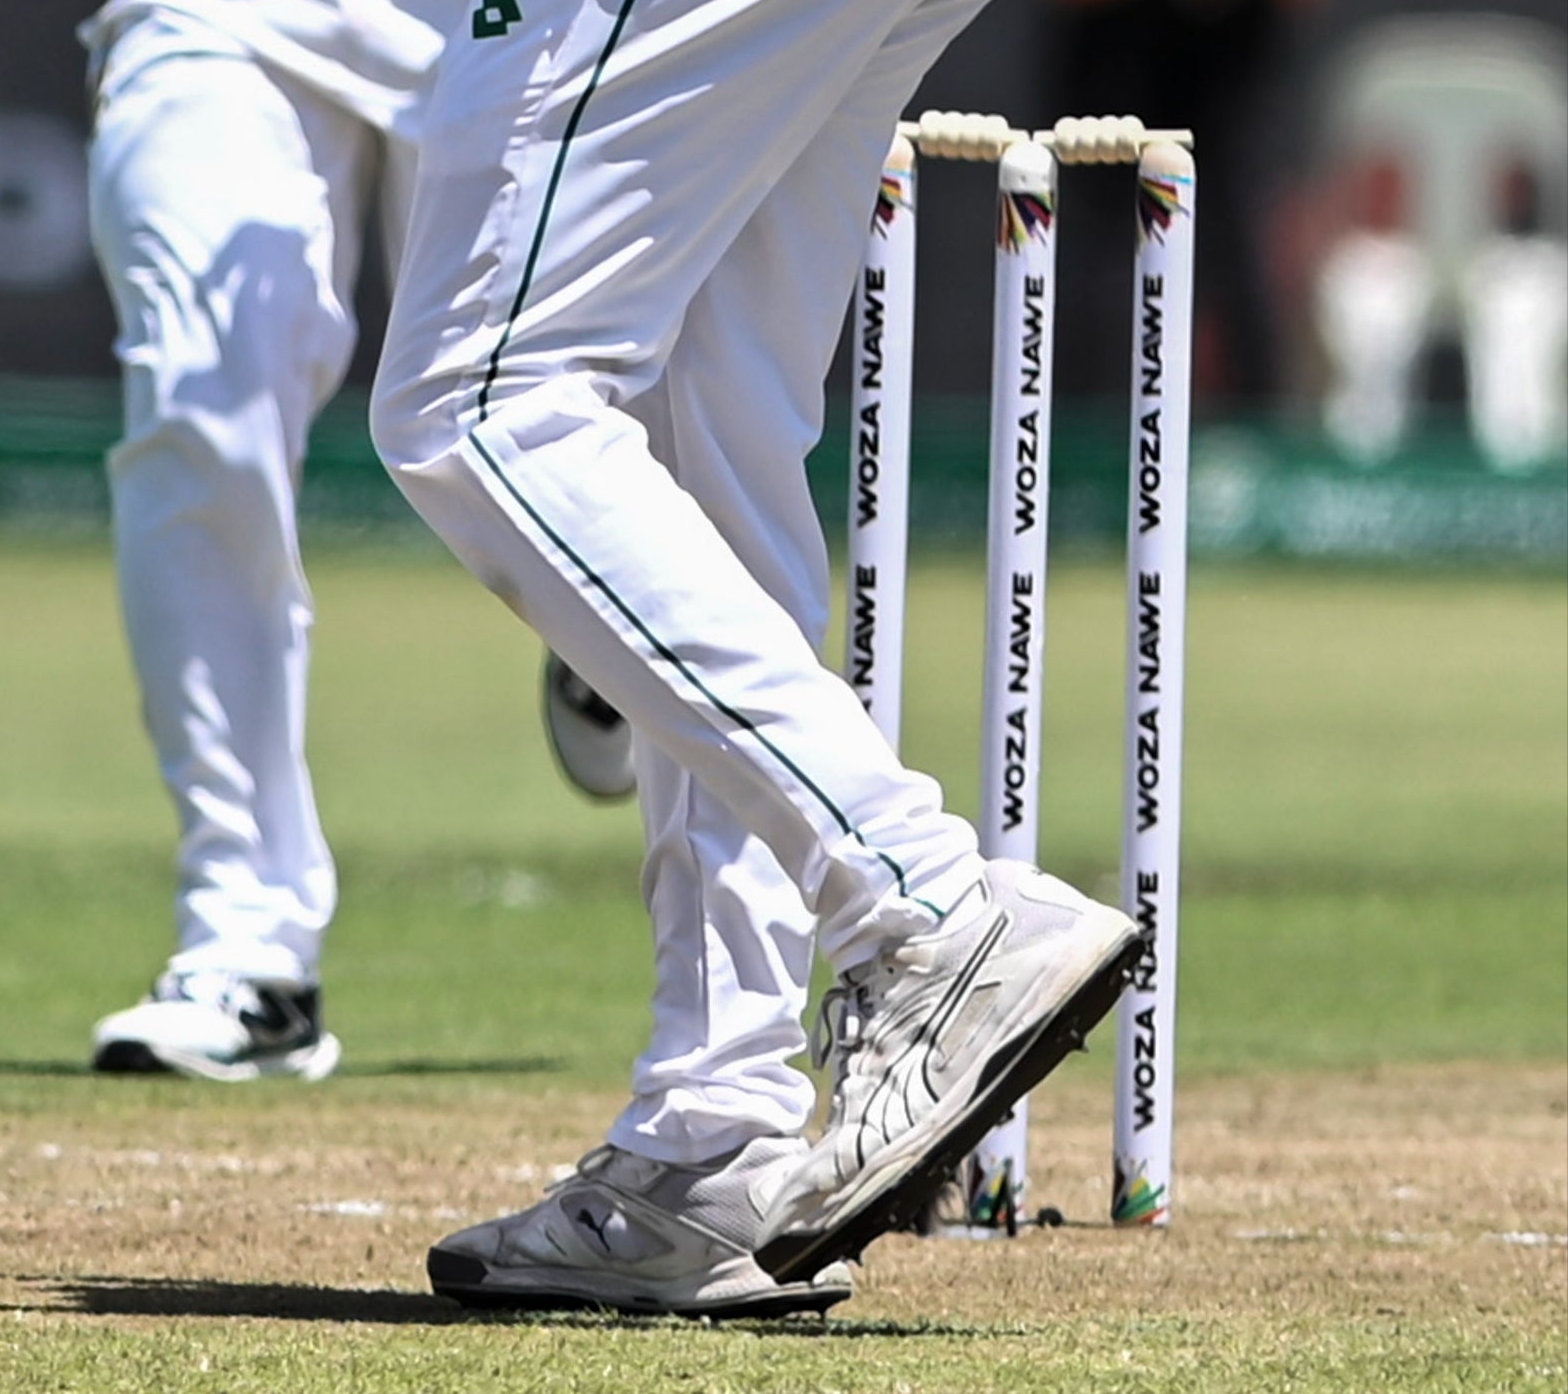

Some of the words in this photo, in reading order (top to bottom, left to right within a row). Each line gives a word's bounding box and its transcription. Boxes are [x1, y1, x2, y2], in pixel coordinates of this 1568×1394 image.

[861, 267, 885, 389] NAWE
[1021, 274, 1044, 395] NAWE
[1141, 274, 1163, 396] NAWE
[857, 401, 880, 528] WOZA
[1015, 410, 1039, 535] WOZA
[1139, 408, 1161, 534] WOZA
[854, 564, 876, 686] NAWE
[1008, 572, 1033, 693] NAWE
[1139, 572, 1161, 693] NAWE
[1002, 707, 1028, 833] WOZA
[1137, 707, 1159, 833] WOZA
[1134, 1007, 1156, 1132] WOZA
